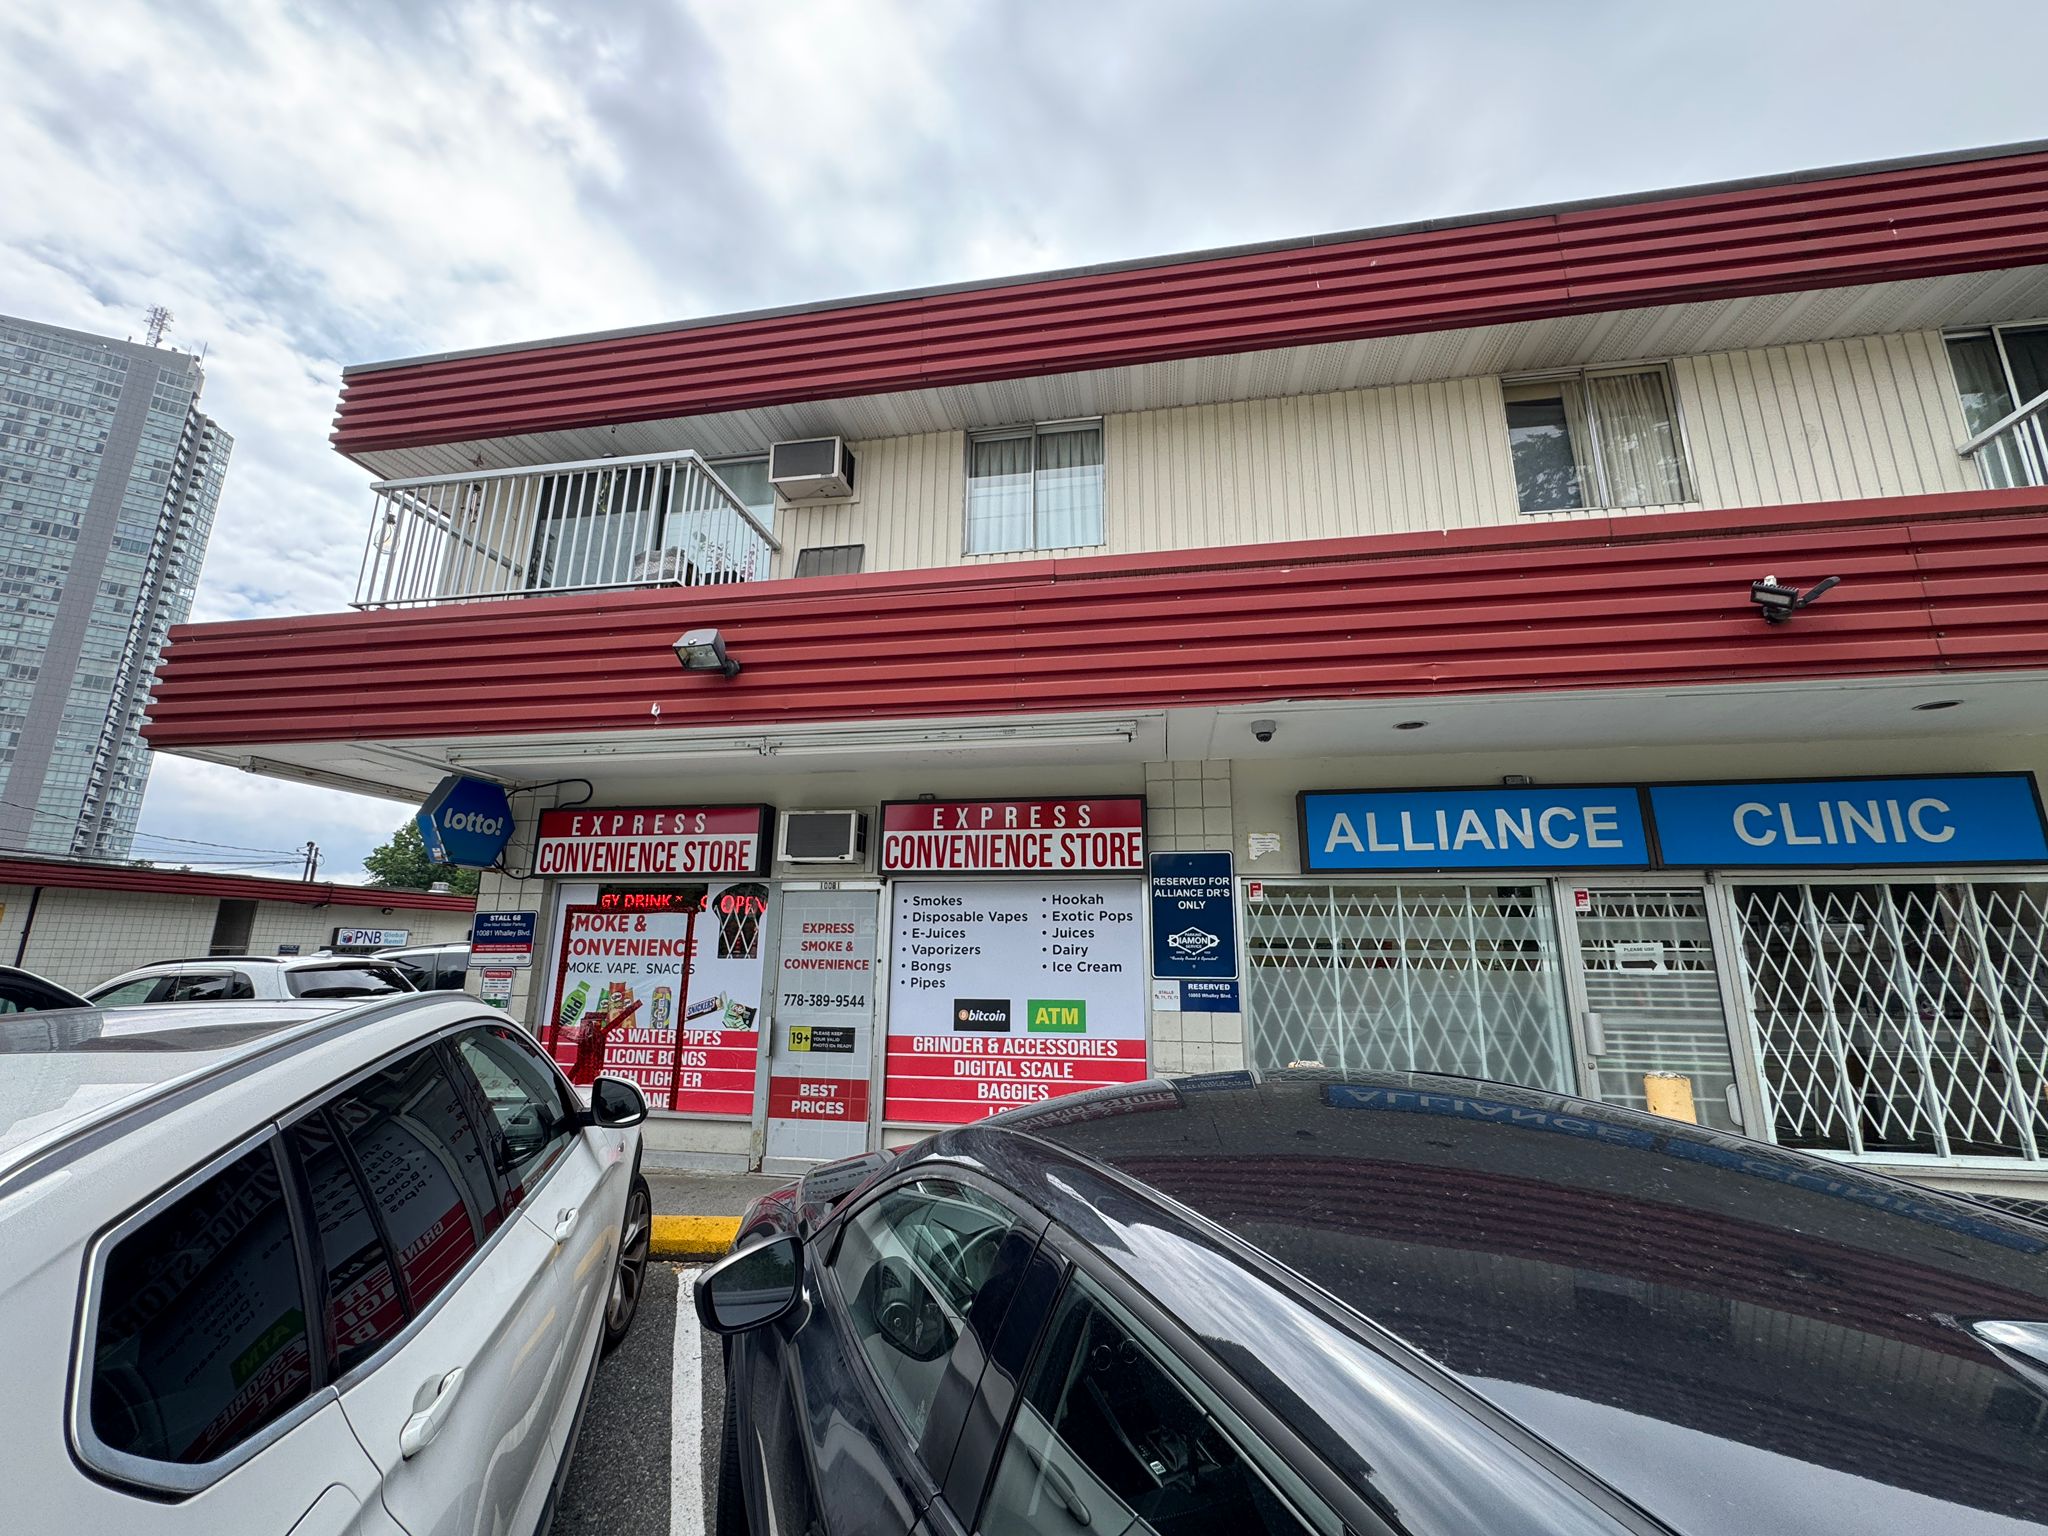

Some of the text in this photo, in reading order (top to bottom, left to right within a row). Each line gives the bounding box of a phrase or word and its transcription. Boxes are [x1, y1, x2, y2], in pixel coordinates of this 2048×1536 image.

[443, 807, 504, 836] lotto!
[932, 804, 1092, 830] EXPRESS
[1732, 798, 1956, 847] CLINIC
[571, 813, 707, 836] EXPRESS
[1324, 806, 1624, 853] ALLIANCE
[539, 840, 752, 874] CONVENIENCE STORE
[884, 831, 1143, 870] CONVENIENCE STORE
[1153, 877, 1230, 886] RESERVED FOR
[1052, 893, 1104, 906] Hookah
[1154, 888, 1230, 897] ALLIANCE DR'S
[624, 894, 670, 908] DRINK
[720, 894, 769, 915] OPEN
[912, 895, 963, 907] Smokes
[1177, 900, 1206, 910] ONLY
[634, 915, 647, 932] &
[912, 911, 1028, 924] Disposable Vapes
[1052, 911, 1134, 924] Exotic Pops
[494, 930, 516, 938] Whalley
[802, 922, 855, 934] EXPRESS
[911, 927, 966, 939] E-Juices
[1052, 927, 1095, 939] Juices
[354, 931, 382, 944] PNB
[801, 940, 854, 952] SMOKE &
[911, 944, 982, 957] Vaporizers
[1052, 944, 1089, 958] Dairy
[567, 962, 695, 975] MOKE. VAPE. SNACS
[784, 958, 870, 971] CONVENIENCE
[911, 961, 952, 973] Bongs
[1052, 961, 1123, 973] Ice Cream
[910, 977, 946, 990] Pipes
[687, 998, 716, 1016] SNICKERS
[783, 993, 865, 1008] 778-389-9544
[968, 1009, 1007, 1023] bitcoin
[1035, 1007, 1079, 1025] ATM
[628, 1029, 676, 1044] WATER
[682, 1030, 722, 1046] PIPES
[791, 1031, 810, 1045] 19+
[912, 1036, 1118, 1057] GRINDER & ACCESSORIES
[953, 1059, 1074, 1079] DIGITAL SCALE
[641, 1071, 702, 1088] LIGHER
[799, 1083, 838, 1097] BEST
[977, 1083, 1049, 1101] BAGGIES
[790, 1100, 845, 1115] PRICES
